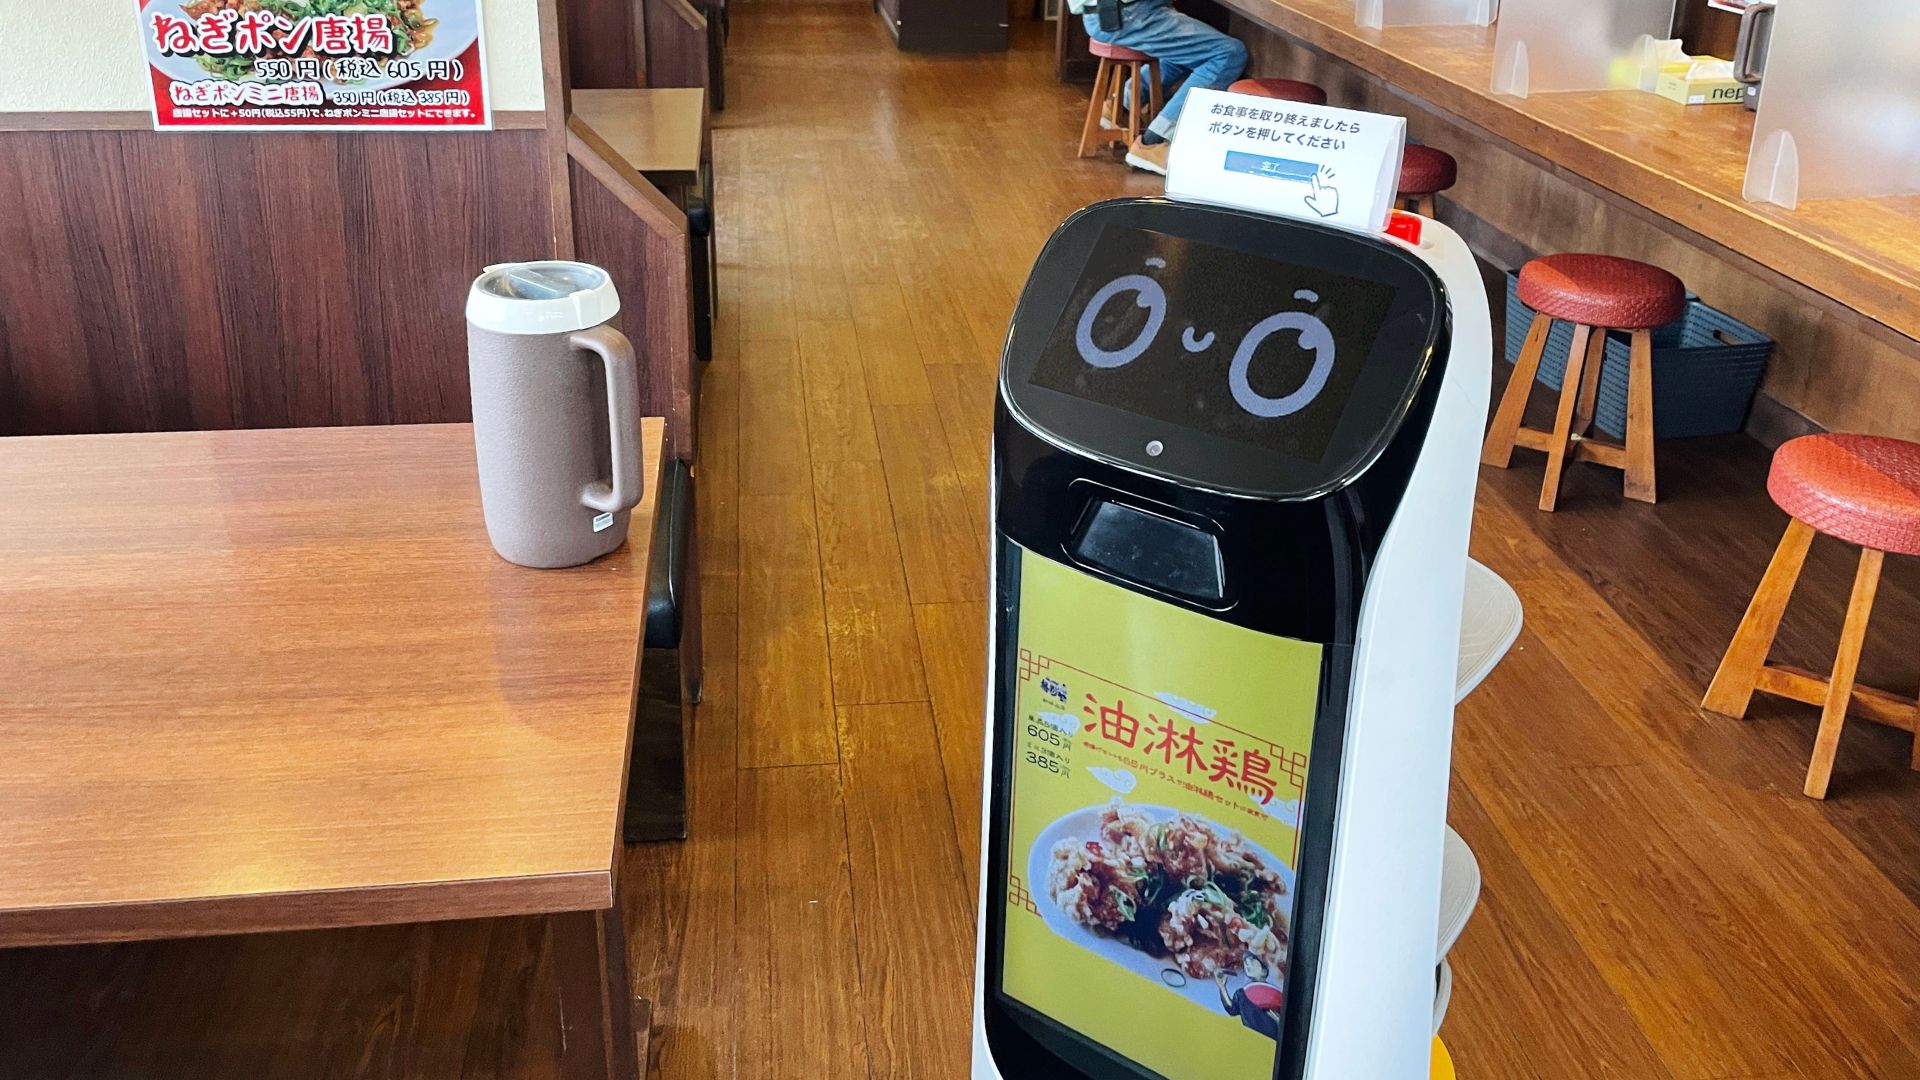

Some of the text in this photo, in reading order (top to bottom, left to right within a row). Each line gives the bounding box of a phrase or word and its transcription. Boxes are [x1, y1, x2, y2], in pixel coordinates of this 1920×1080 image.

[153, 12, 393, 52] ねぎポン唐揚
[173, 83, 320, 102] ねぎポンミニ唐揚
[1210, 103, 1361, 134] お食事を取り終えましたら
[1208, 121, 1346, 151] ボタンを押してください
[1083, 693, 1277, 806] 油淋鶏
